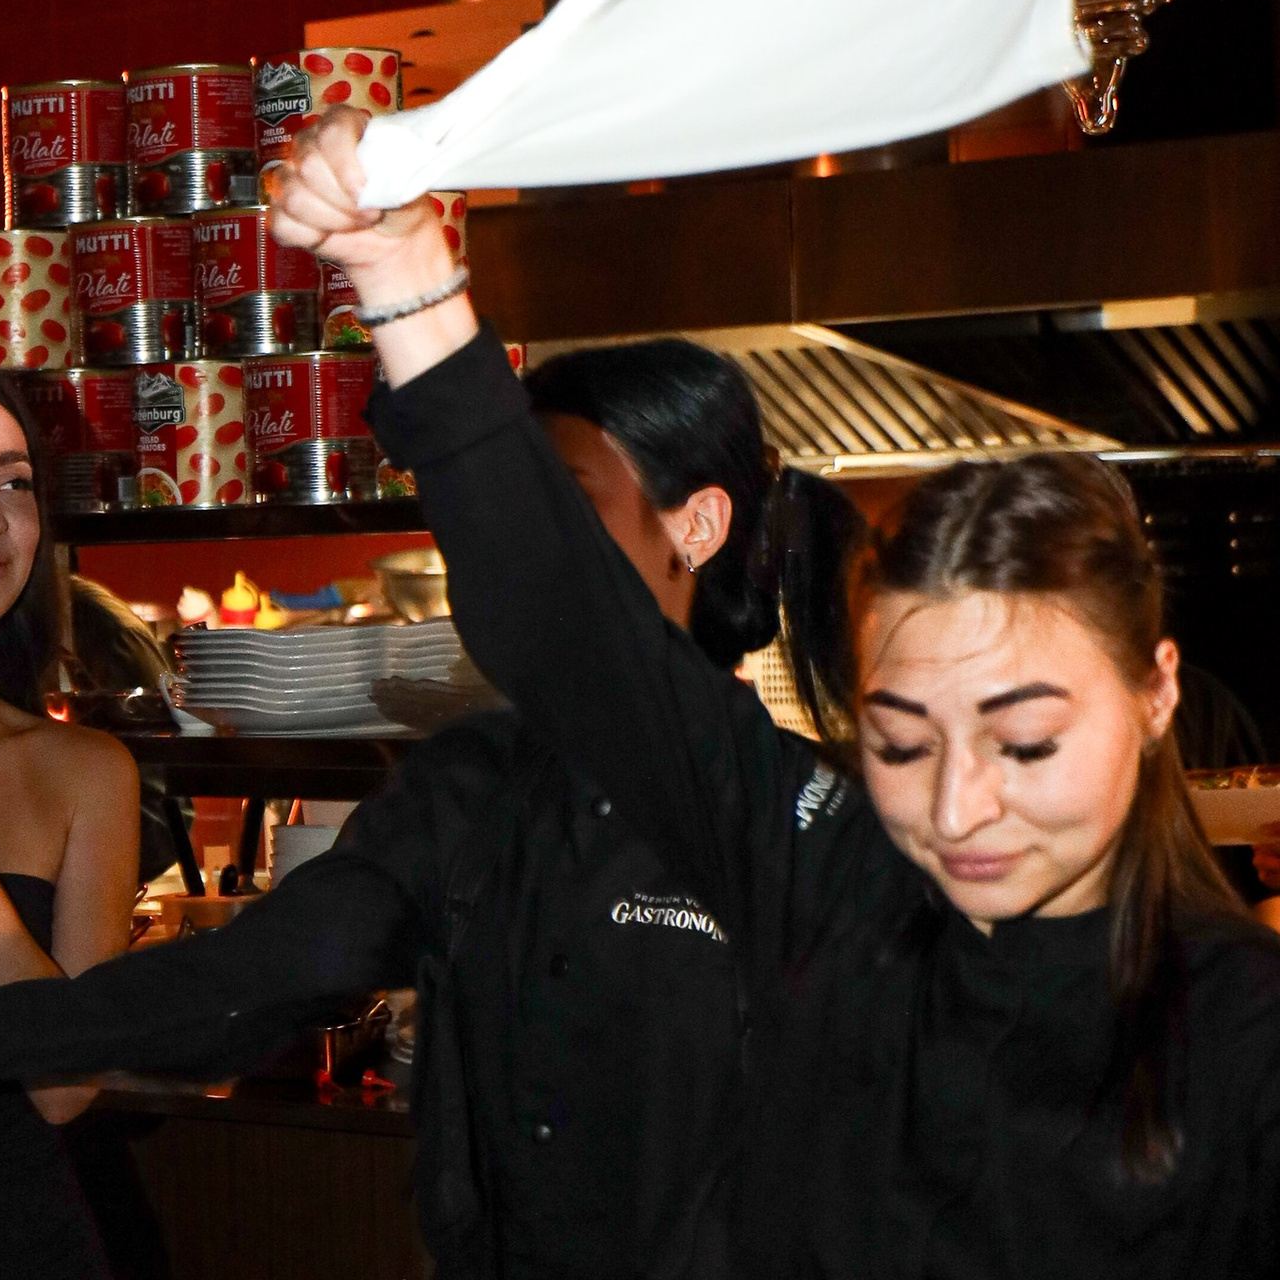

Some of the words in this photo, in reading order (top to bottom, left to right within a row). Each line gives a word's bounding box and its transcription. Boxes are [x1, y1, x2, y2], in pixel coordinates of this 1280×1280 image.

[11, 97, 65, 119] MUTTI
[11, 134, 68, 161] Pelati
[75, 233, 130, 254] MUTTI
[76, 271, 133, 298] Pelati
[327, 280, 355, 291] TOMATO
[331, 272, 348, 282] PEEL
